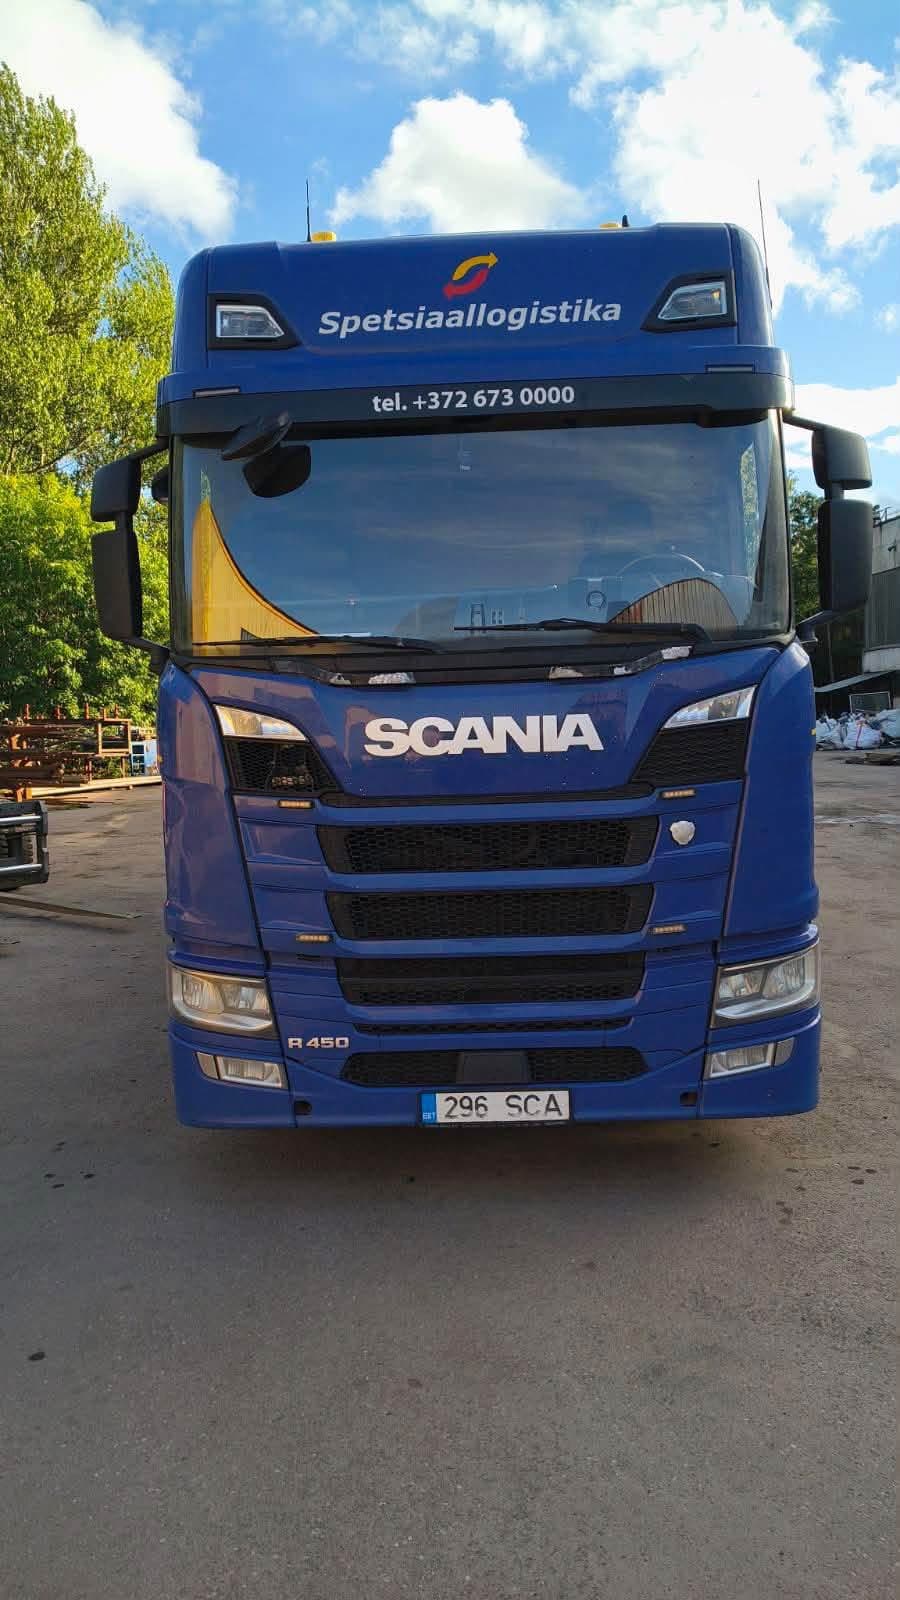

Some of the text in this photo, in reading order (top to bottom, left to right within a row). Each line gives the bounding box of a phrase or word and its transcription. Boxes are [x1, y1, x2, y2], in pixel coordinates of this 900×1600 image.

[318, 298, 622, 339] Spetsiaallogistika
[372, 386, 575, 412] tel. +372 673 0000
[364, 713, 604, 757] SCANIA
[288, 1037, 349, 1049] R 450
[444, 1093, 563, 1119] 296 SCA
